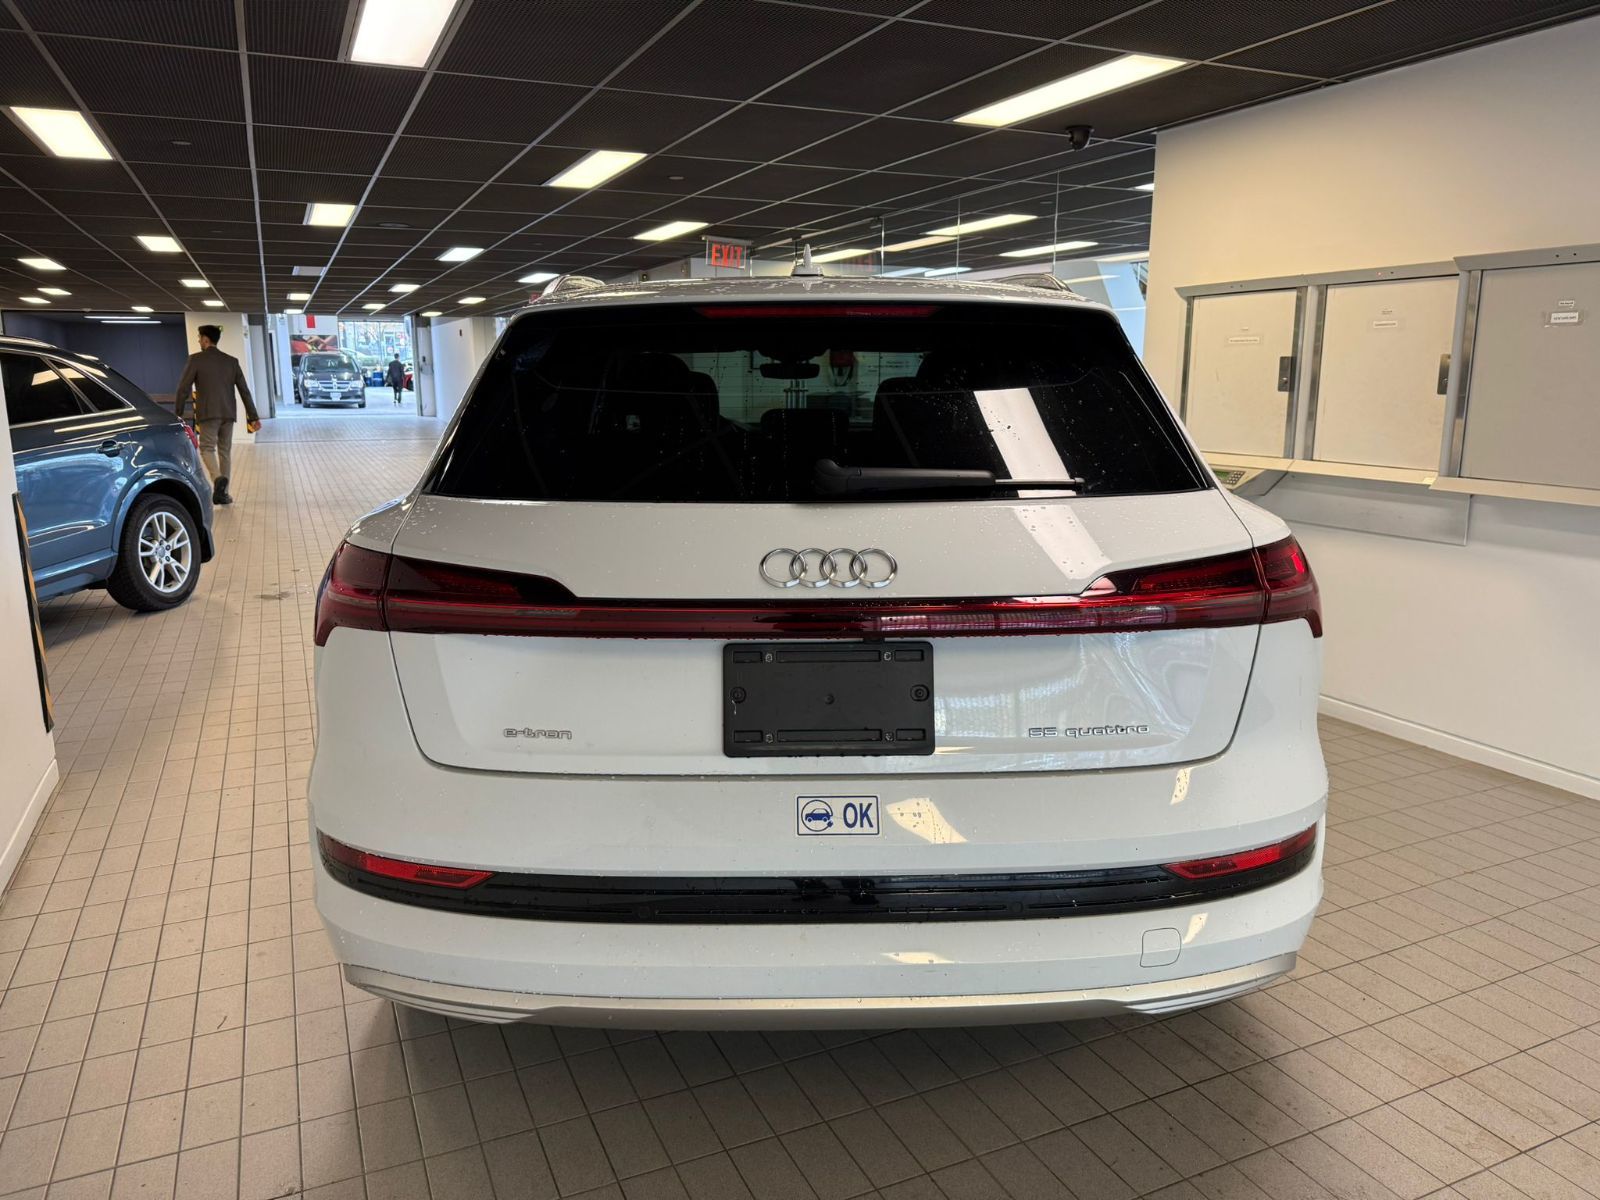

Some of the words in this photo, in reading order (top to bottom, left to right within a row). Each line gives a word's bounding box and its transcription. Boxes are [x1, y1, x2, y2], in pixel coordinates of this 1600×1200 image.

[711, 244, 743, 268] EXIT
[503, 727, 572, 740] e-tron
[1029, 727, 1058, 738] 55
[1065, 725, 1149, 738] quattro
[843, 802, 873, 828] OK
